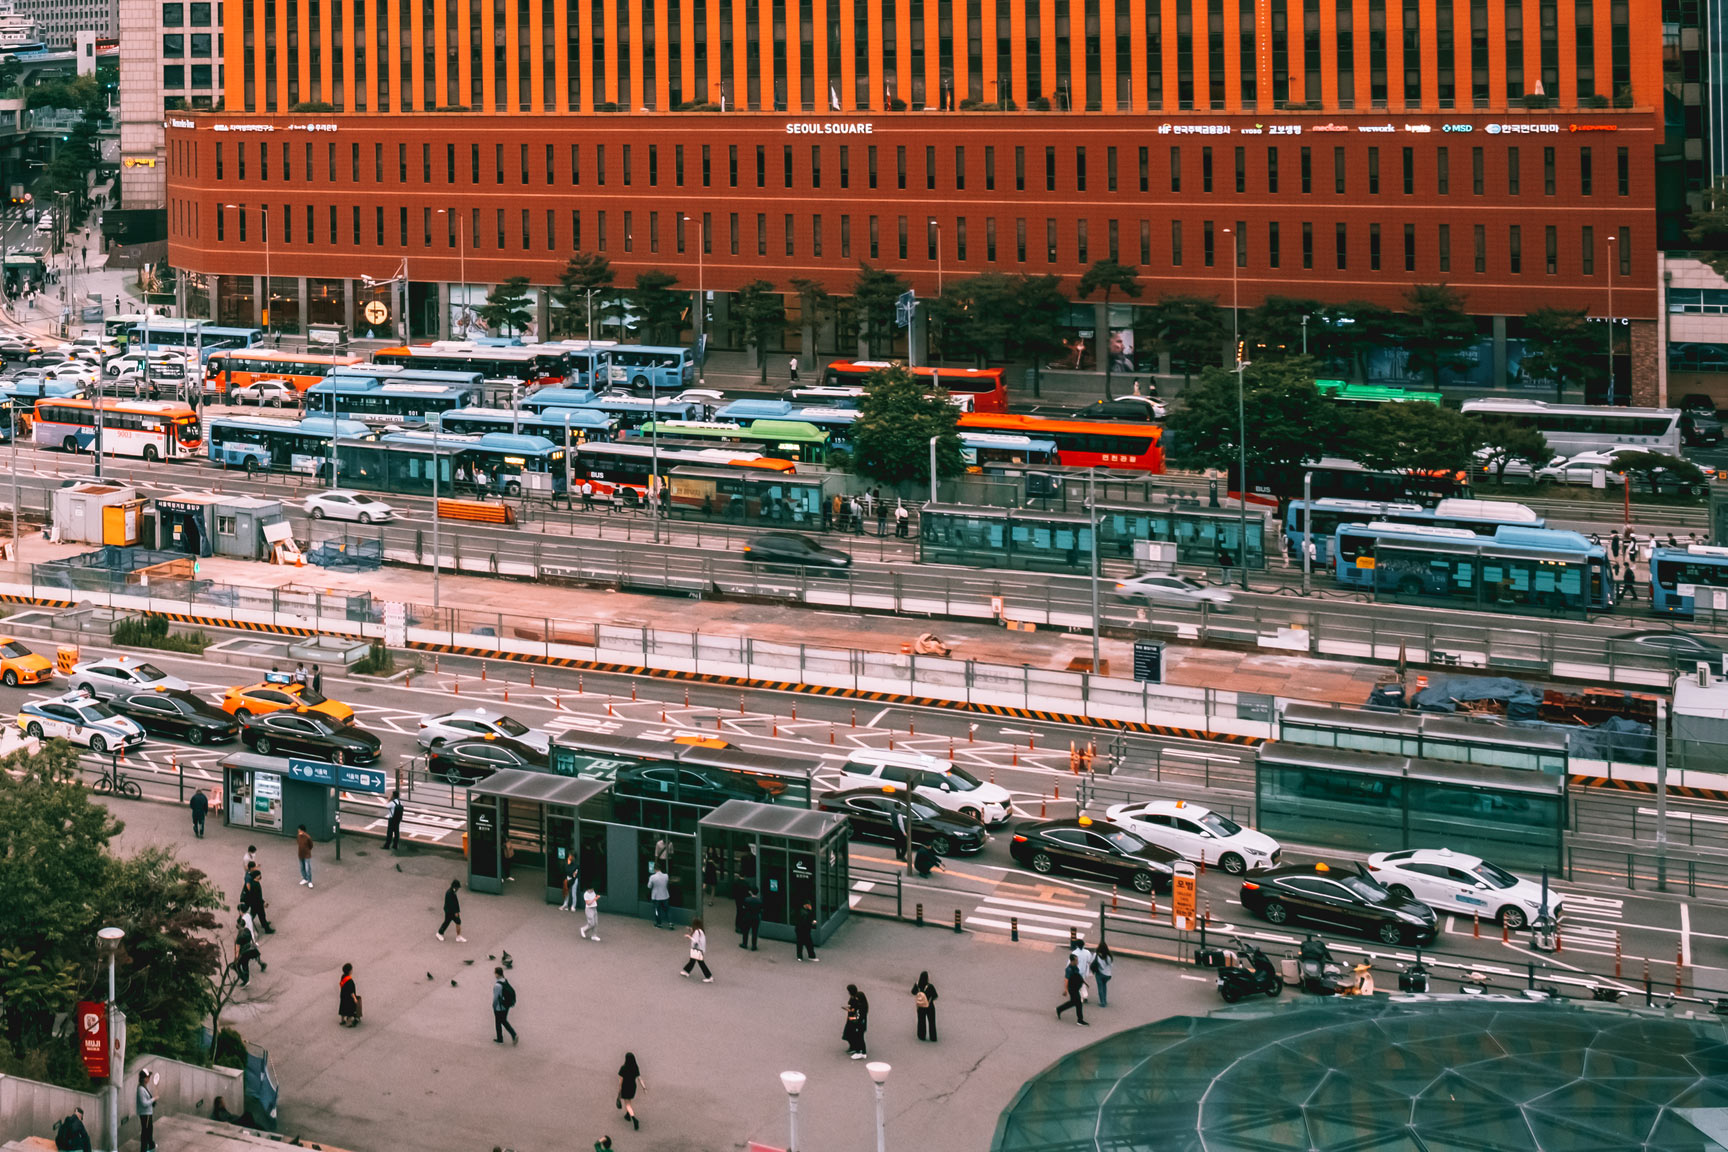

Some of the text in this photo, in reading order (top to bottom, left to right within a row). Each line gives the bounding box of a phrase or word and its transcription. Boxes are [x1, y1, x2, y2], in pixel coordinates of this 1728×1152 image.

[786, 123, 873, 134] SEOUL SQUARE
[1173, 125, 1231, 135] 한국주택금융공사
[1268, 125, 1302, 135] 교보생명
[1358, 123, 1396, 132] wework
[1452, 124, 1473, 132] MSD
[1501, 124, 1559, 133] 한국먼디파마
[1210, 481, 1216, 489] 6
[1176, 880, 1194, 891] 모범
[84, 1039, 101, 1048] MUJI
